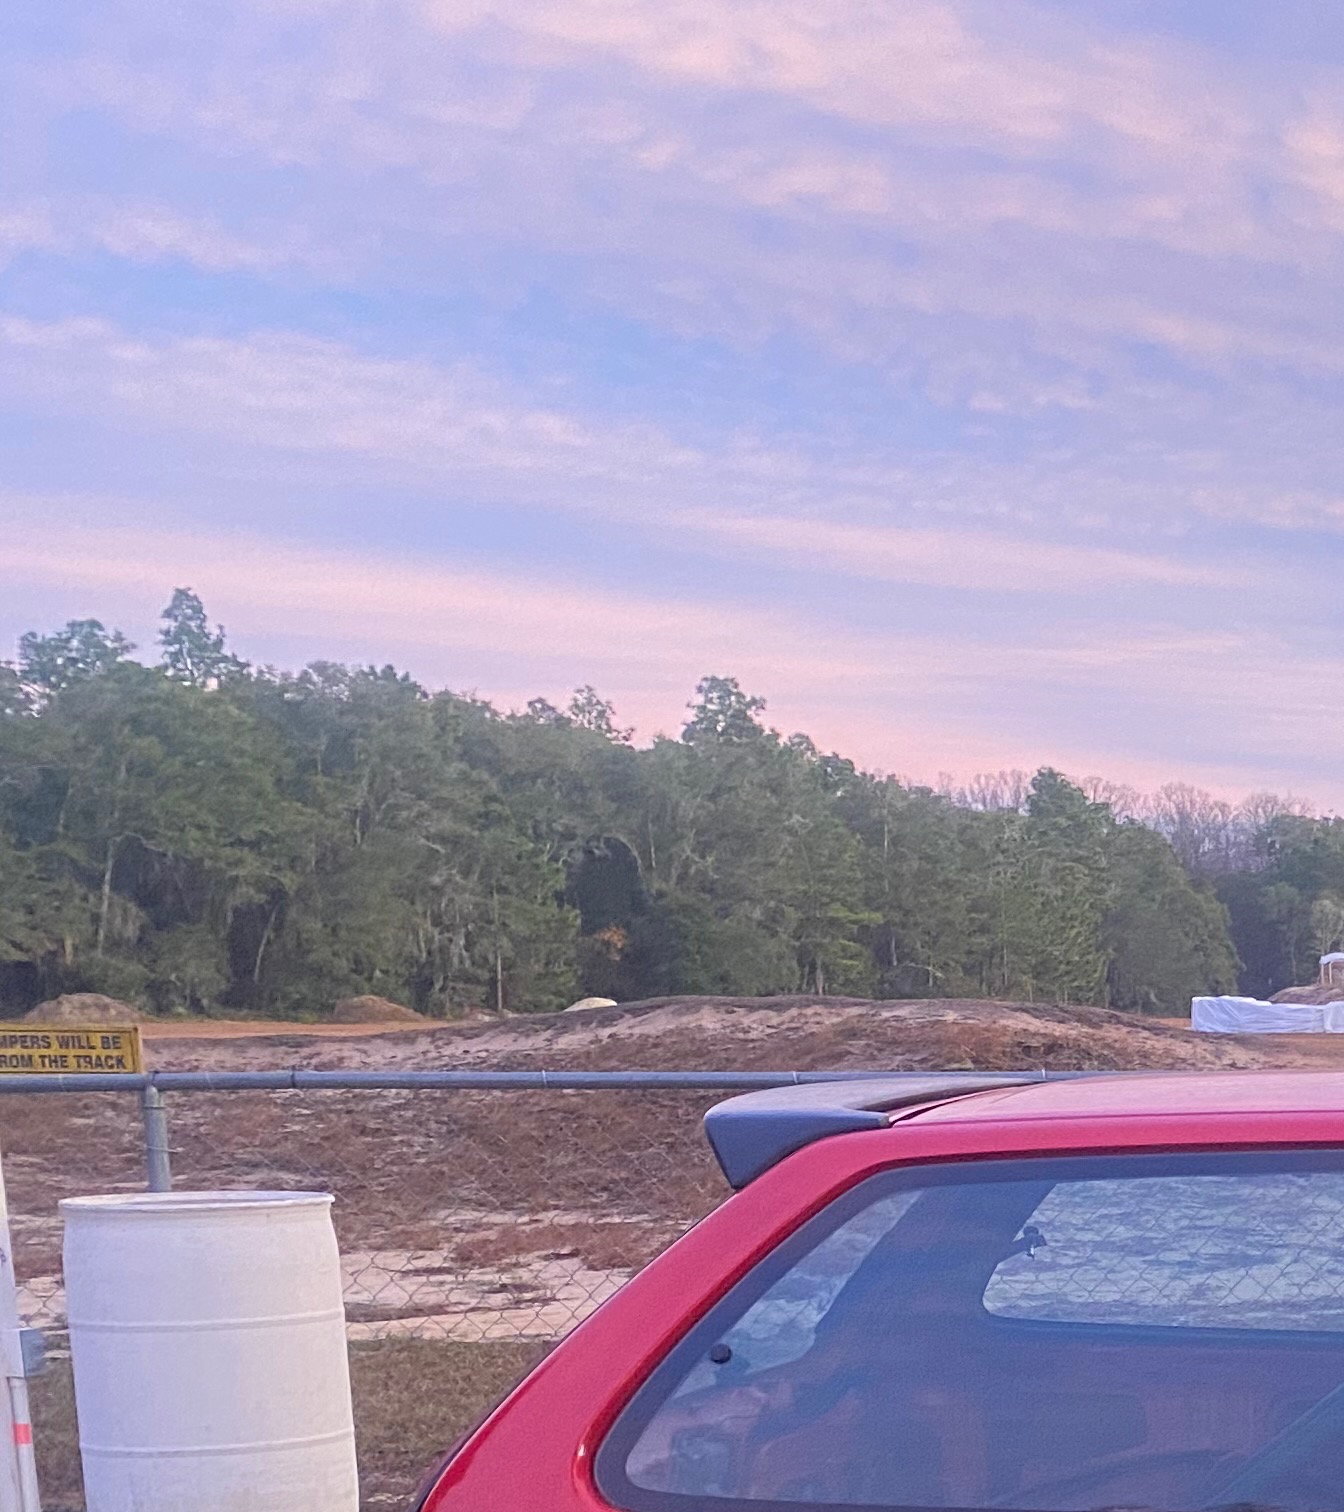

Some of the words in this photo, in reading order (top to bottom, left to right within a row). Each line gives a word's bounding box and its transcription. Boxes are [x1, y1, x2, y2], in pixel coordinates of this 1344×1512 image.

[56, 1036, 96, 1050] WILL
[100, 1036, 122, 1050] BE
[39, 1055, 69, 1069] THE
[73, 1055, 127, 1070] TRACK
